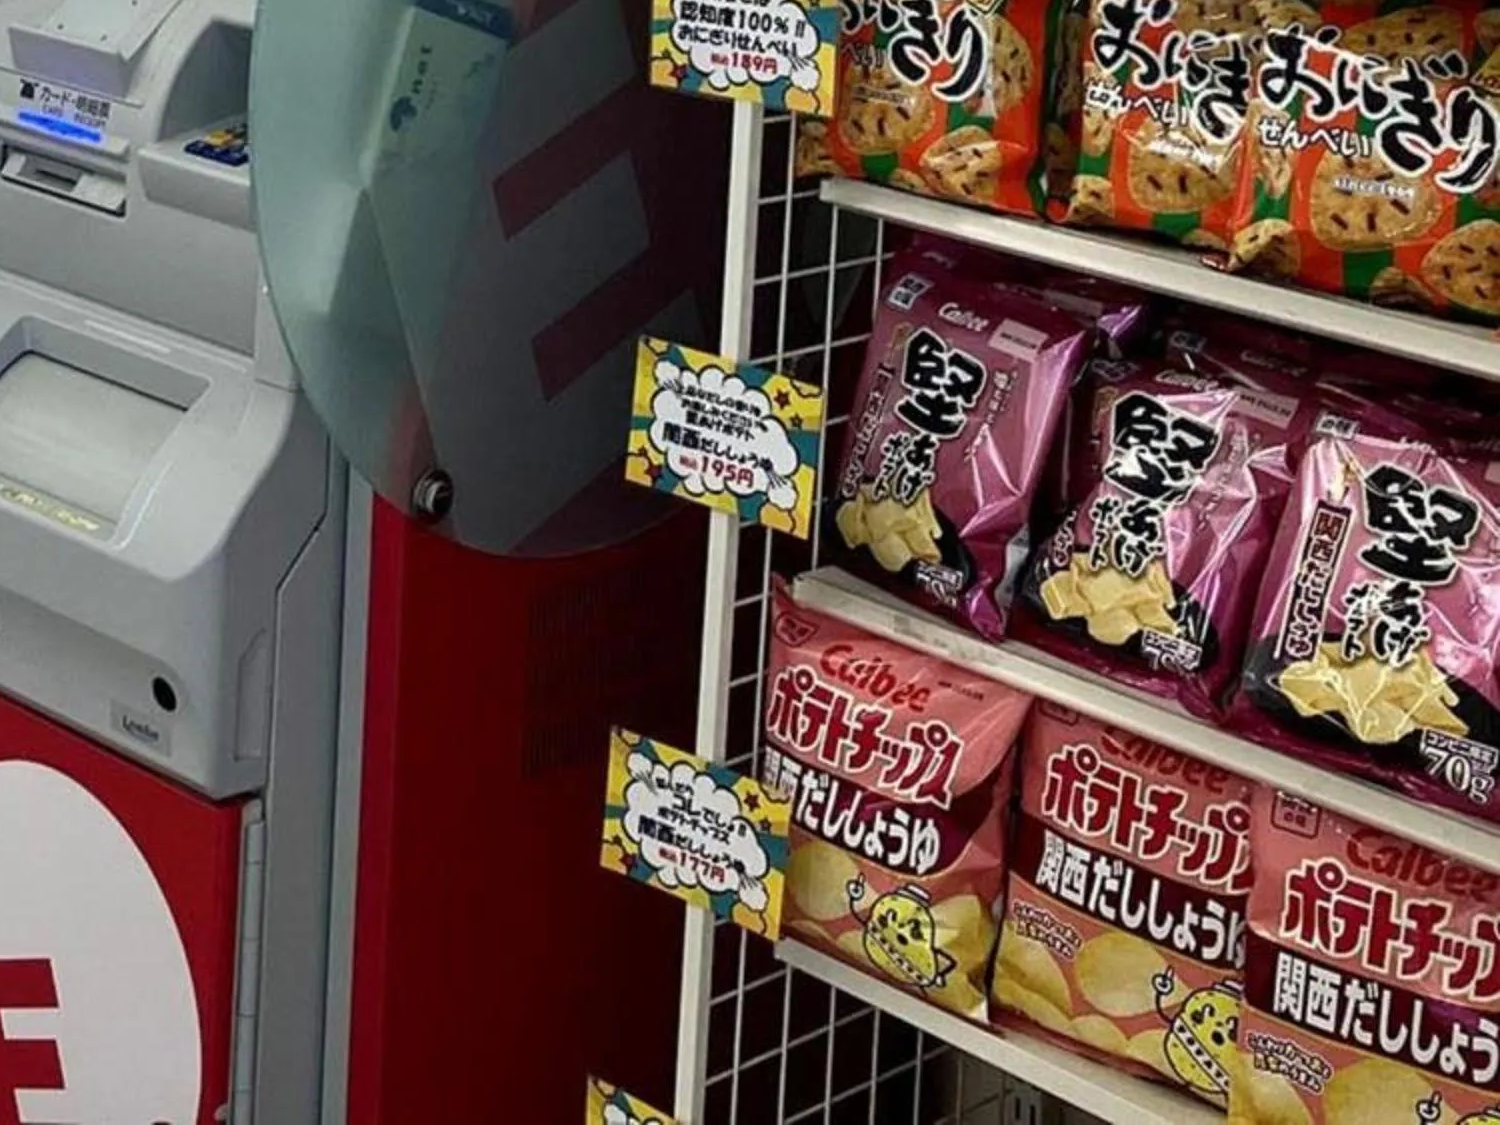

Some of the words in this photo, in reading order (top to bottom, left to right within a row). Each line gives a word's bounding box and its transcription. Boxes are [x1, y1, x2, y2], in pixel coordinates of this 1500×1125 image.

[677, 24, 798, 57] おにぎりせんべい
[1257, 25, 1498, 193] おにぎり
[1256, 117, 1374, 159] せんべい
[938, 302, 989, 332] Calbee
[662, 421, 775, 472] 関西だししょうゆ
[766, 664, 964, 810] ポテトチップス
[637, 814, 746, 875] 関西だししょうゆ
[1347, 828, 1500, 903] Calbee
